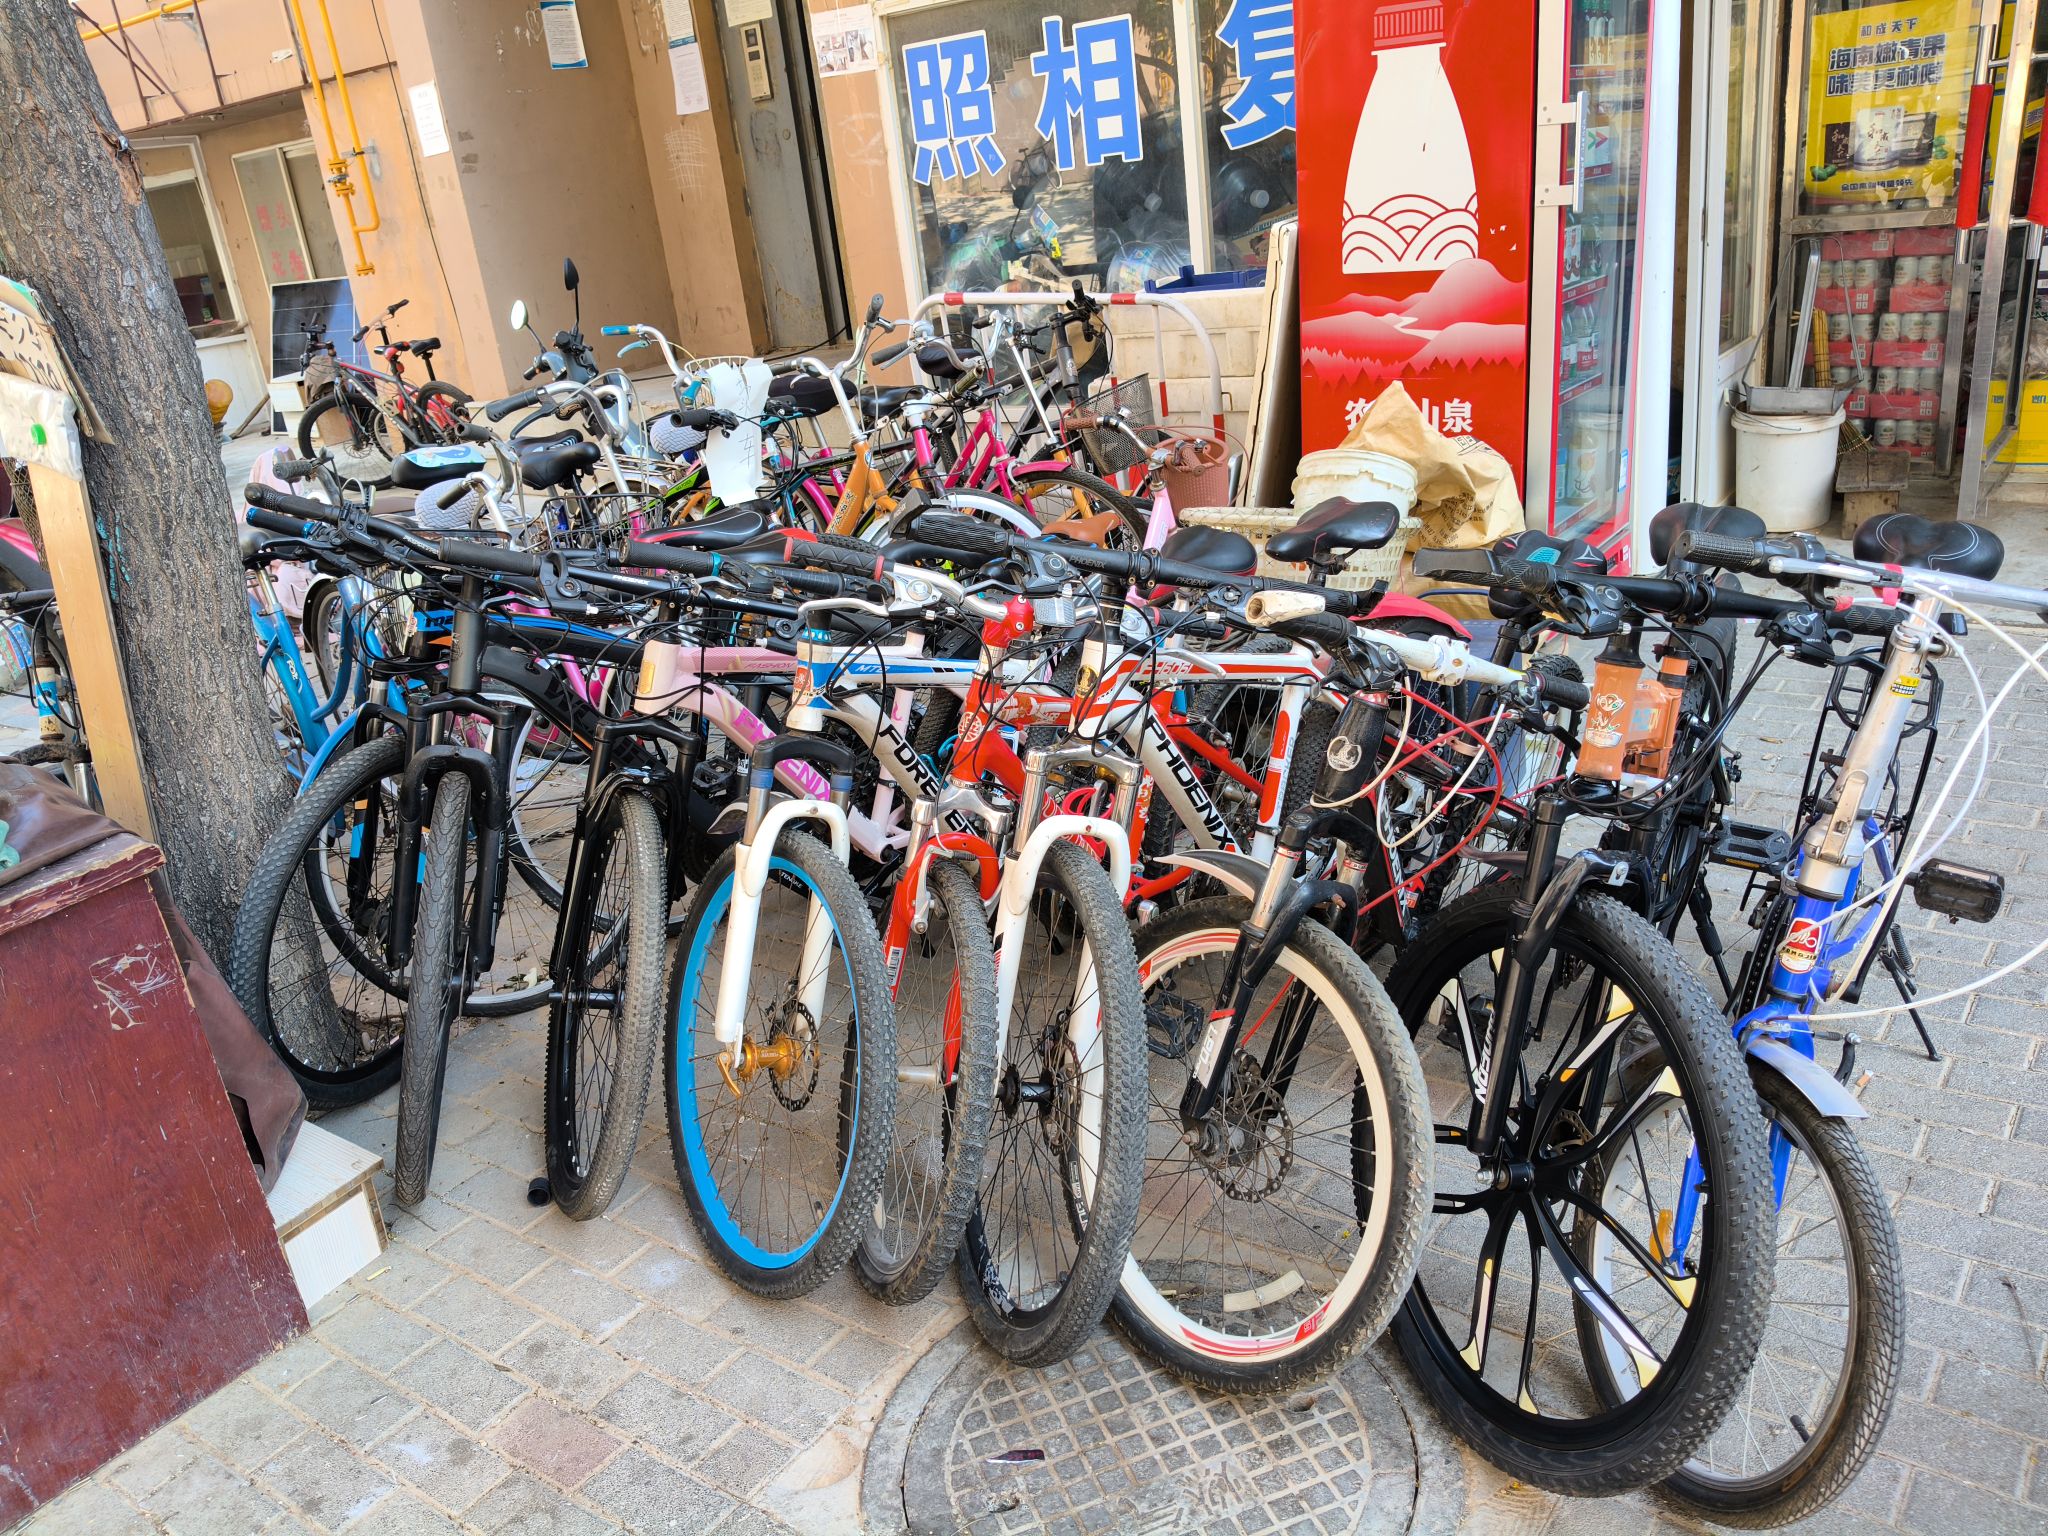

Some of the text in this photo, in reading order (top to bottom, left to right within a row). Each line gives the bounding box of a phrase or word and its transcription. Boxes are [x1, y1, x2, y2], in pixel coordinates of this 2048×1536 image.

[1860, 17, 1918, 38] 和成天下
[1828, 32, 1948, 72] 海南嫩青果
[1344, 397, 1473, 433] 农山泉
[1069, 555, 1106, 570] PHOENIX
[1175, 576, 1211, 588] PHOENIX
[1144, 713, 1236, 851] PHOENIX
